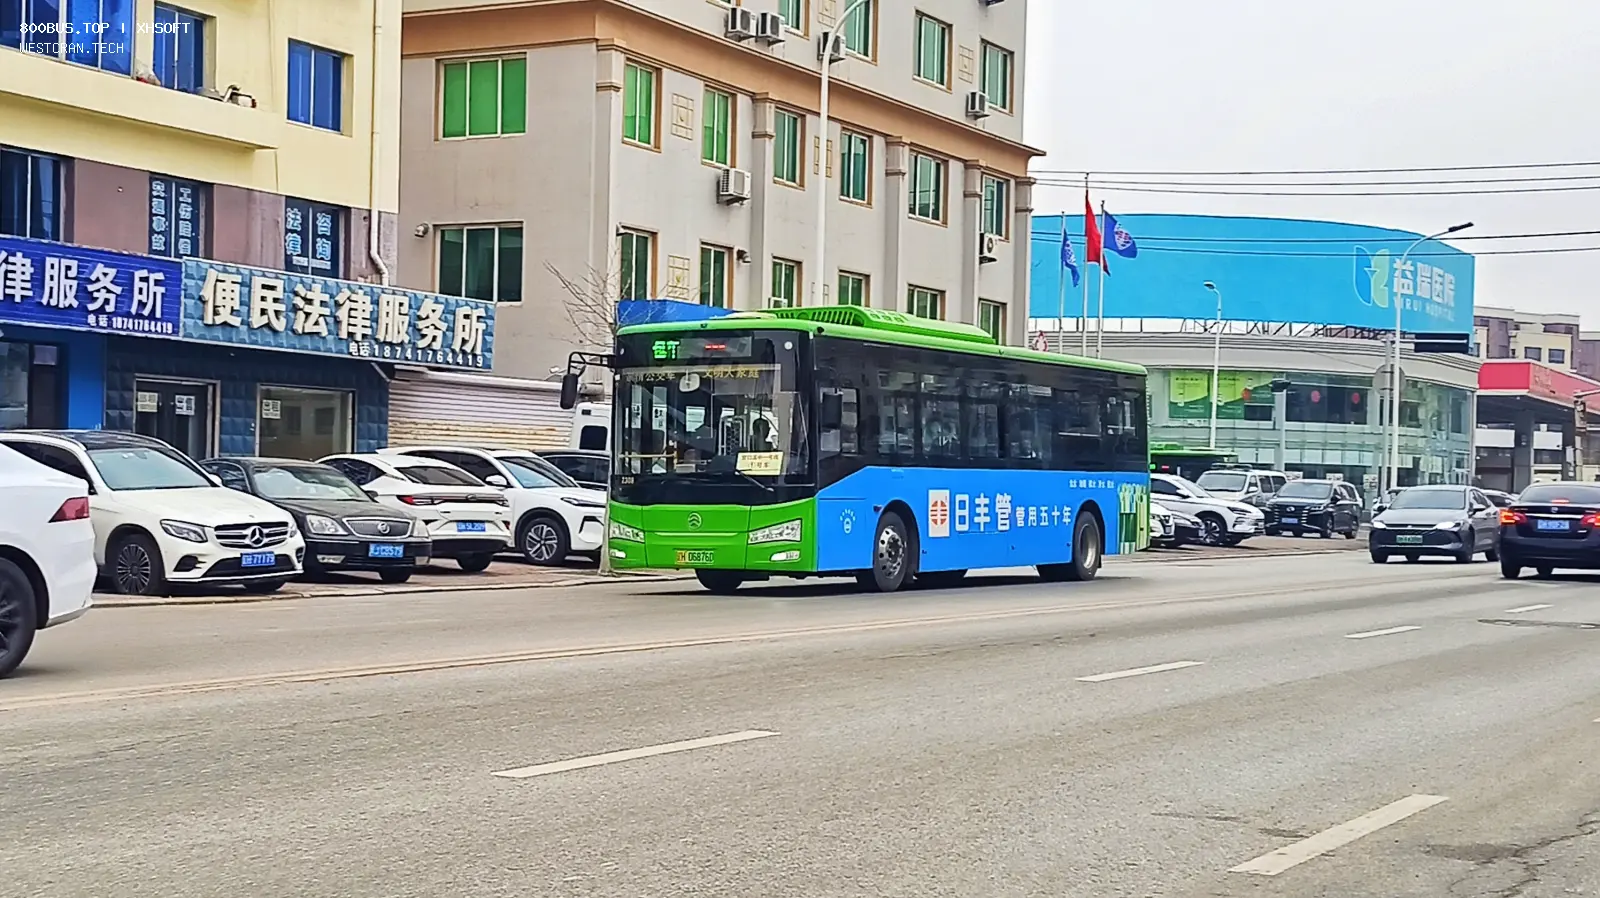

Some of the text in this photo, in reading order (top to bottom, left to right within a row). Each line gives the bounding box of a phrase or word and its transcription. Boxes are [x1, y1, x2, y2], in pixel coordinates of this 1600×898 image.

[0, 250, 166, 319] 律服务所
[200, 268, 487, 355] 便民法律服务所
[350, 341, 484, 367] 电话 18741764419
[955, 492, 1012, 532] 日丰管
